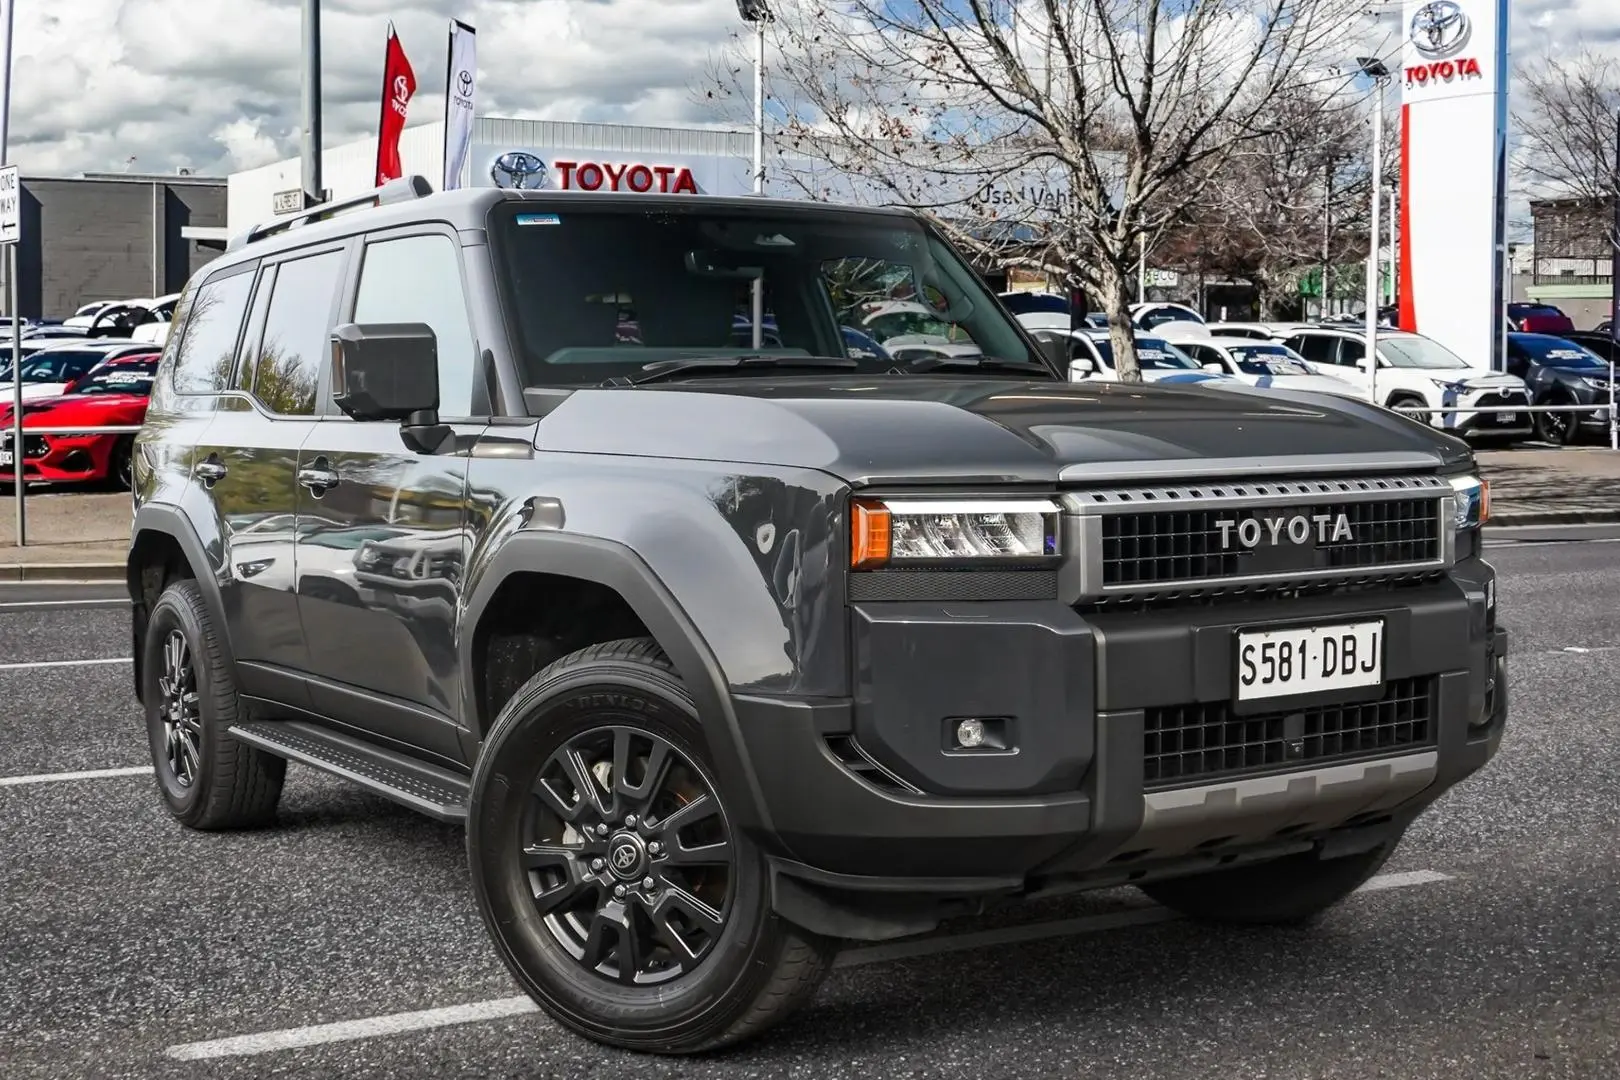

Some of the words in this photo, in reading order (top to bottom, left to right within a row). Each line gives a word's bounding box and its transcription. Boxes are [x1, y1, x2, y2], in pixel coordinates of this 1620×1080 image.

[1404, 58, 1481, 83] TOYOTA
[1, 173, 15, 191] ONE
[555, 162, 698, 194] TOYOTA
[1, 196, 16, 214] WAY
[979, 183, 1025, 205] Used
[1215, 513, 1353, 549] TOYOTA
